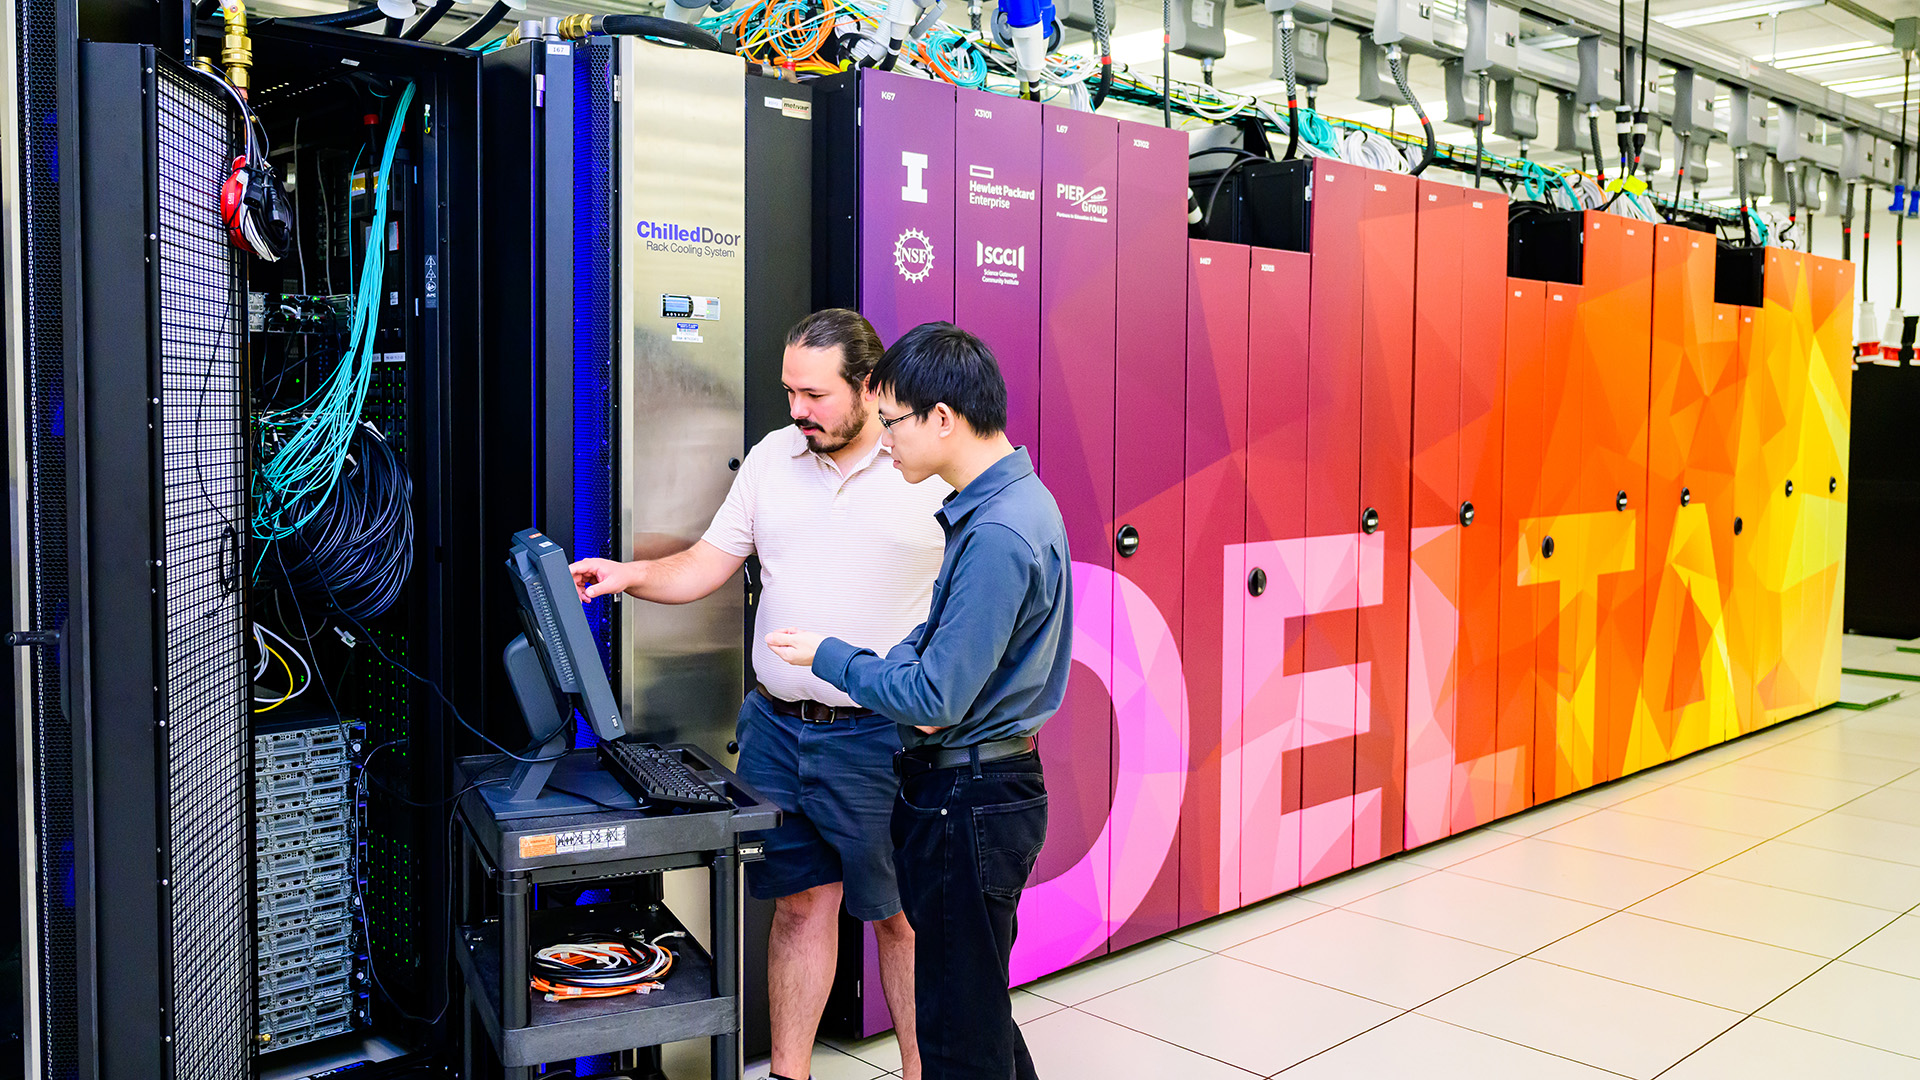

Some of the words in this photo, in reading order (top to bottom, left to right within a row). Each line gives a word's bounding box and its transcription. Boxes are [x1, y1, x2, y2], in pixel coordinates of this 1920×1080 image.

[881, 91, 896, 101] K67
[1056, 124, 1068, 133] L67
[901, 151, 928, 204] I
[969, 180, 1002, 196] Hewlett
[1003, 184, 1035, 201] Packard
[1056, 183, 1085, 201] PIER
[969, 192, 1011, 210] Enterprise
[1081, 200, 1109, 217] Group
[636, 220, 742, 247] ChilledDoor
[646, 240, 670, 253] Rack
[670, 242, 703, 257] Cooling
[704, 245, 736, 258] System
[901, 247, 928, 264] NSF
[984, 245, 1017, 267] SGCI
